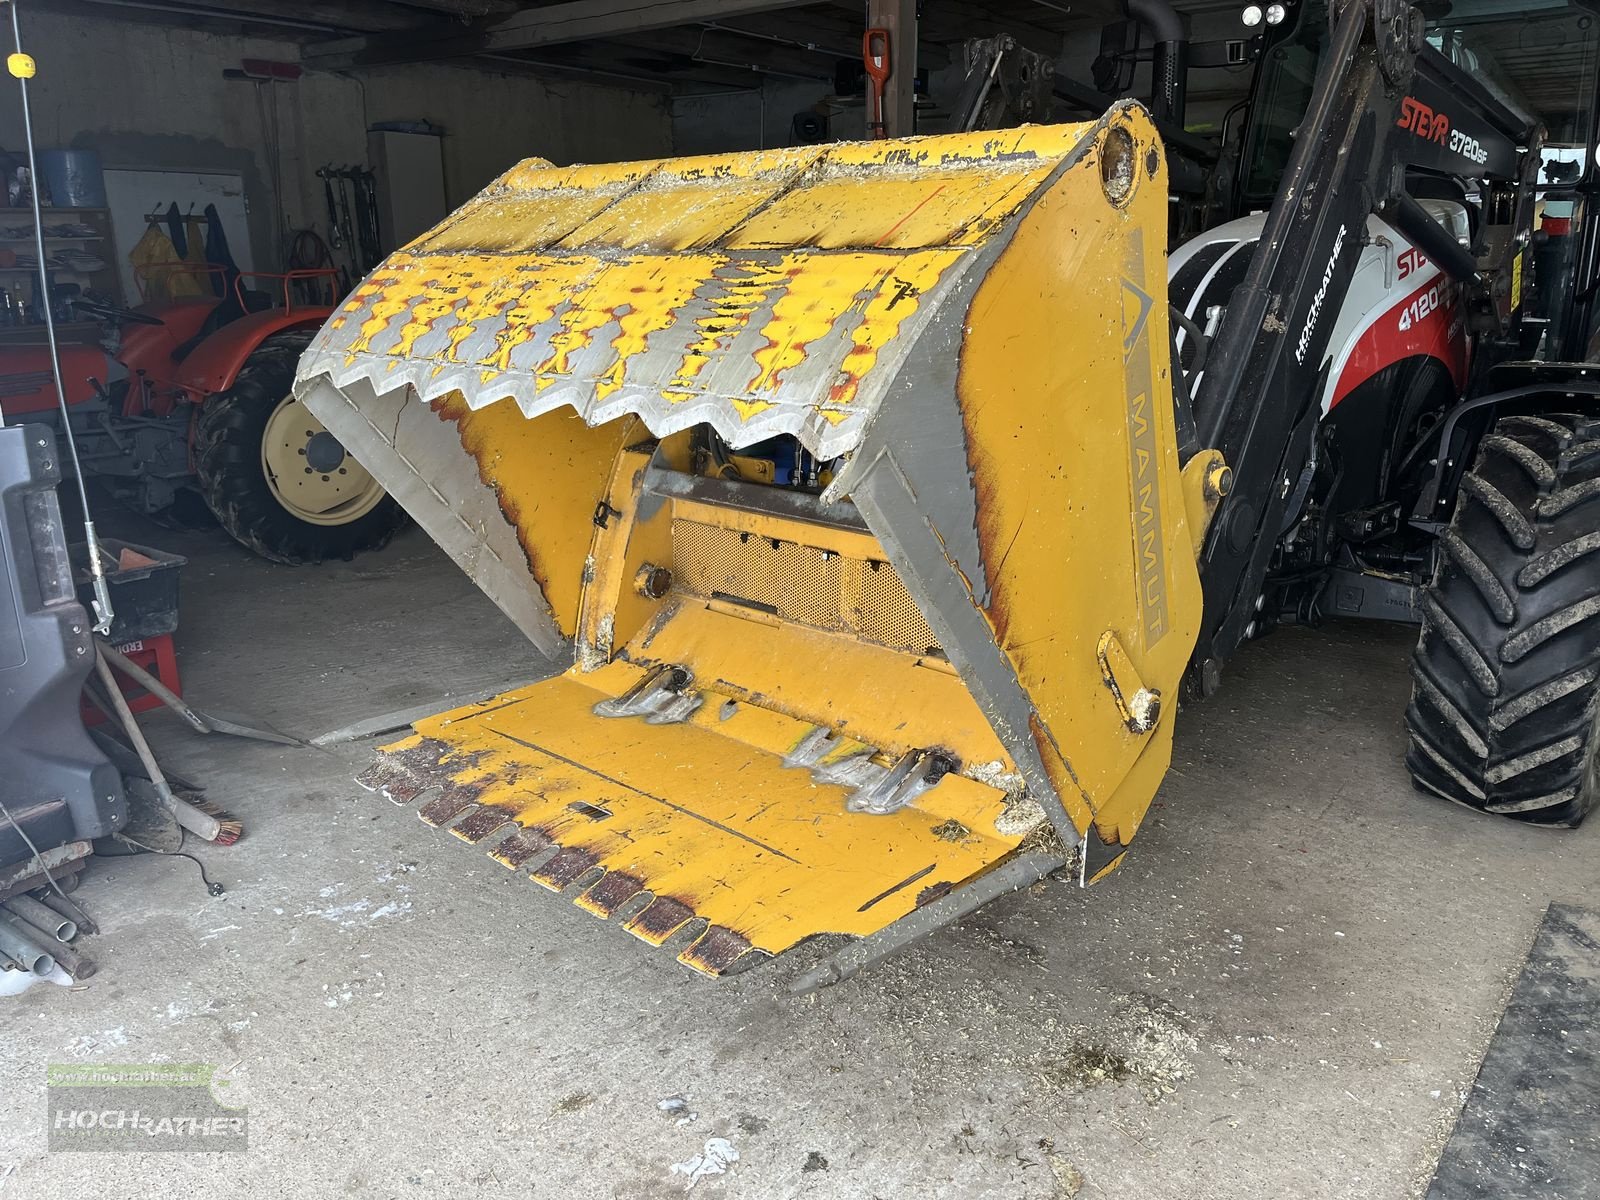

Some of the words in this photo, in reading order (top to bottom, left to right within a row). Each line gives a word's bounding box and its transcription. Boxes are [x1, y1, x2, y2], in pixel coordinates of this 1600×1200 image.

[1396, 96, 1449, 147] STEYR
[1398, 286, 1439, 332] 4120
[1132, 391, 1163, 636] MAMMUT
